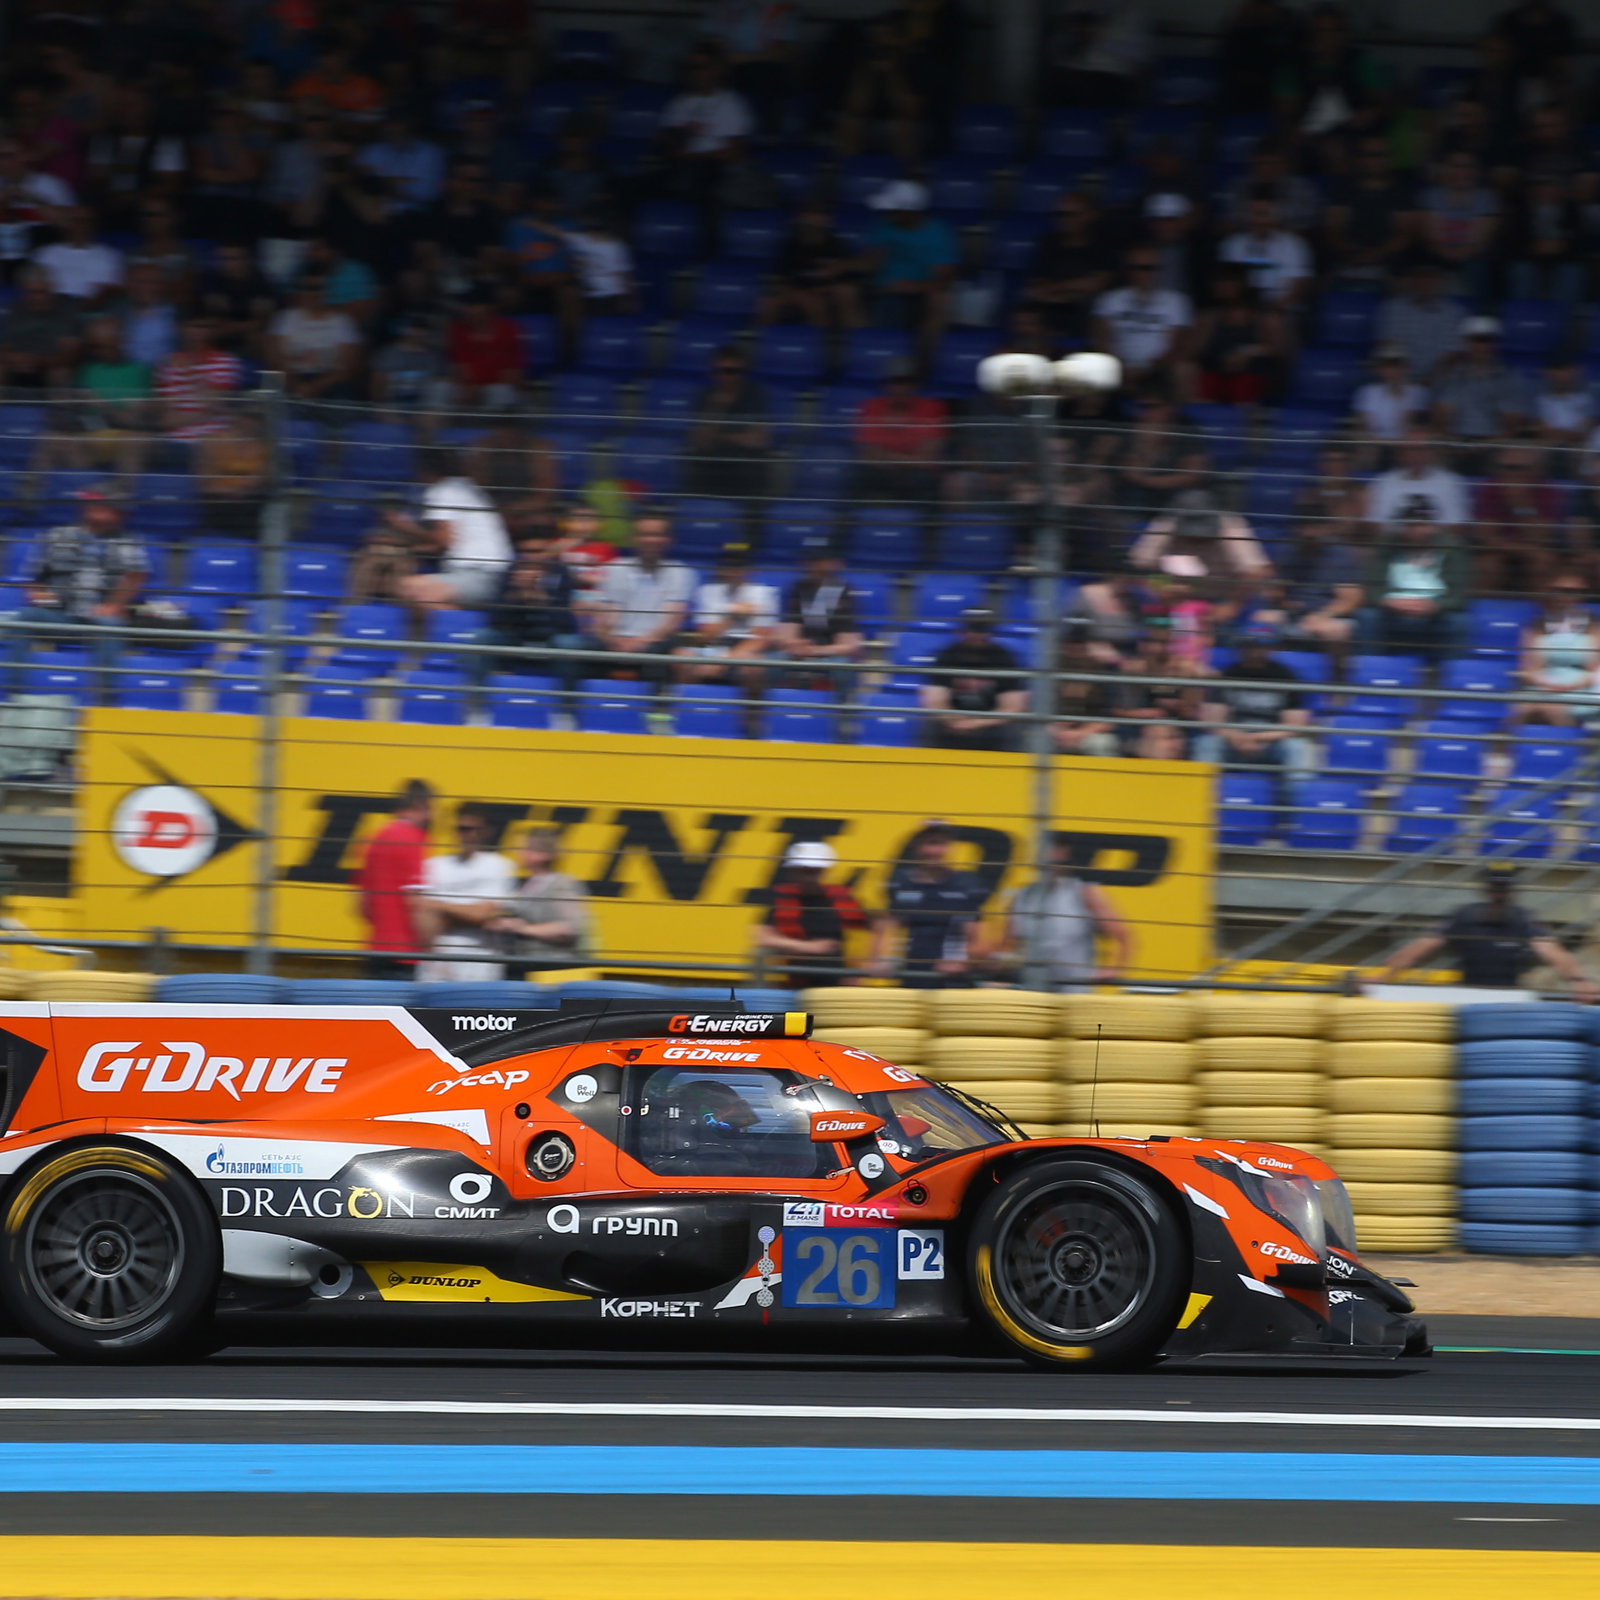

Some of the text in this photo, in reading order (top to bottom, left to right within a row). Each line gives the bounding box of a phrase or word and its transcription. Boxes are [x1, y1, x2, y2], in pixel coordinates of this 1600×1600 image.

[452, 1015, 516, 1030] motor
[221, 1186, 415, 1218] DRAGON
[434, 1207, 500, 1219] СМИТ
[827, 1204, 895, 1220] TOTAL
[903, 1237, 940, 1272] P2
[795, 1235, 881, 1305] 26
[409, 1275, 482, 1288] DUNLOP
